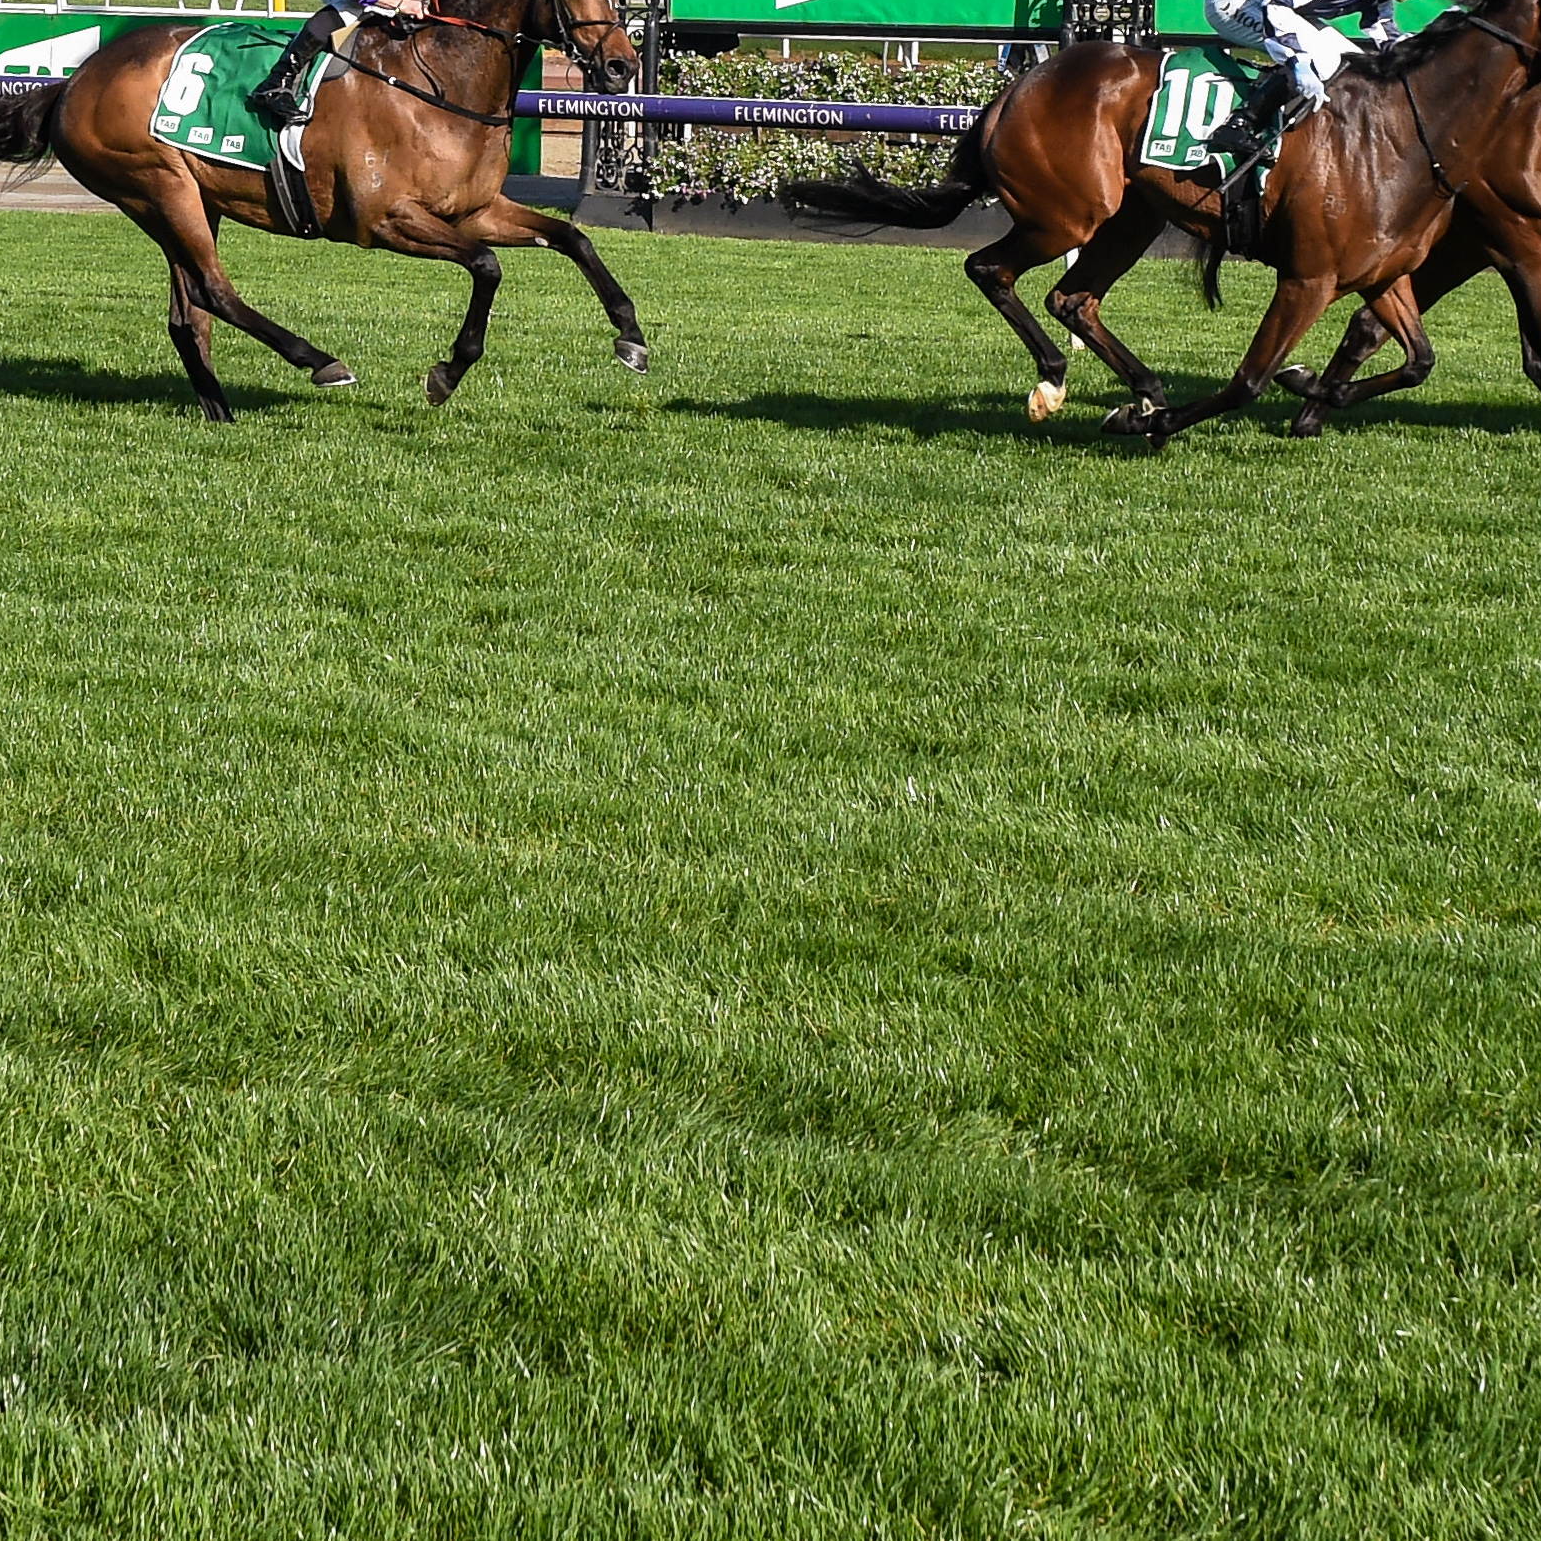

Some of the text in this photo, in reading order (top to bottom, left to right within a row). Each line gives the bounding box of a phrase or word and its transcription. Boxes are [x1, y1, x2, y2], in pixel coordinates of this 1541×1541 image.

[162, 52, 214, 116] 6
[537, 97, 645, 118] FLEMINGTON
[1162, 68, 1235, 141] 10
[159, 117, 176, 130] TAB
[734, 104, 844, 126] FLEMINGTON
[193, 129, 210, 142] TAB
[225, 138, 241, 150] TAB
[1154, 142, 1172, 153] TAB
